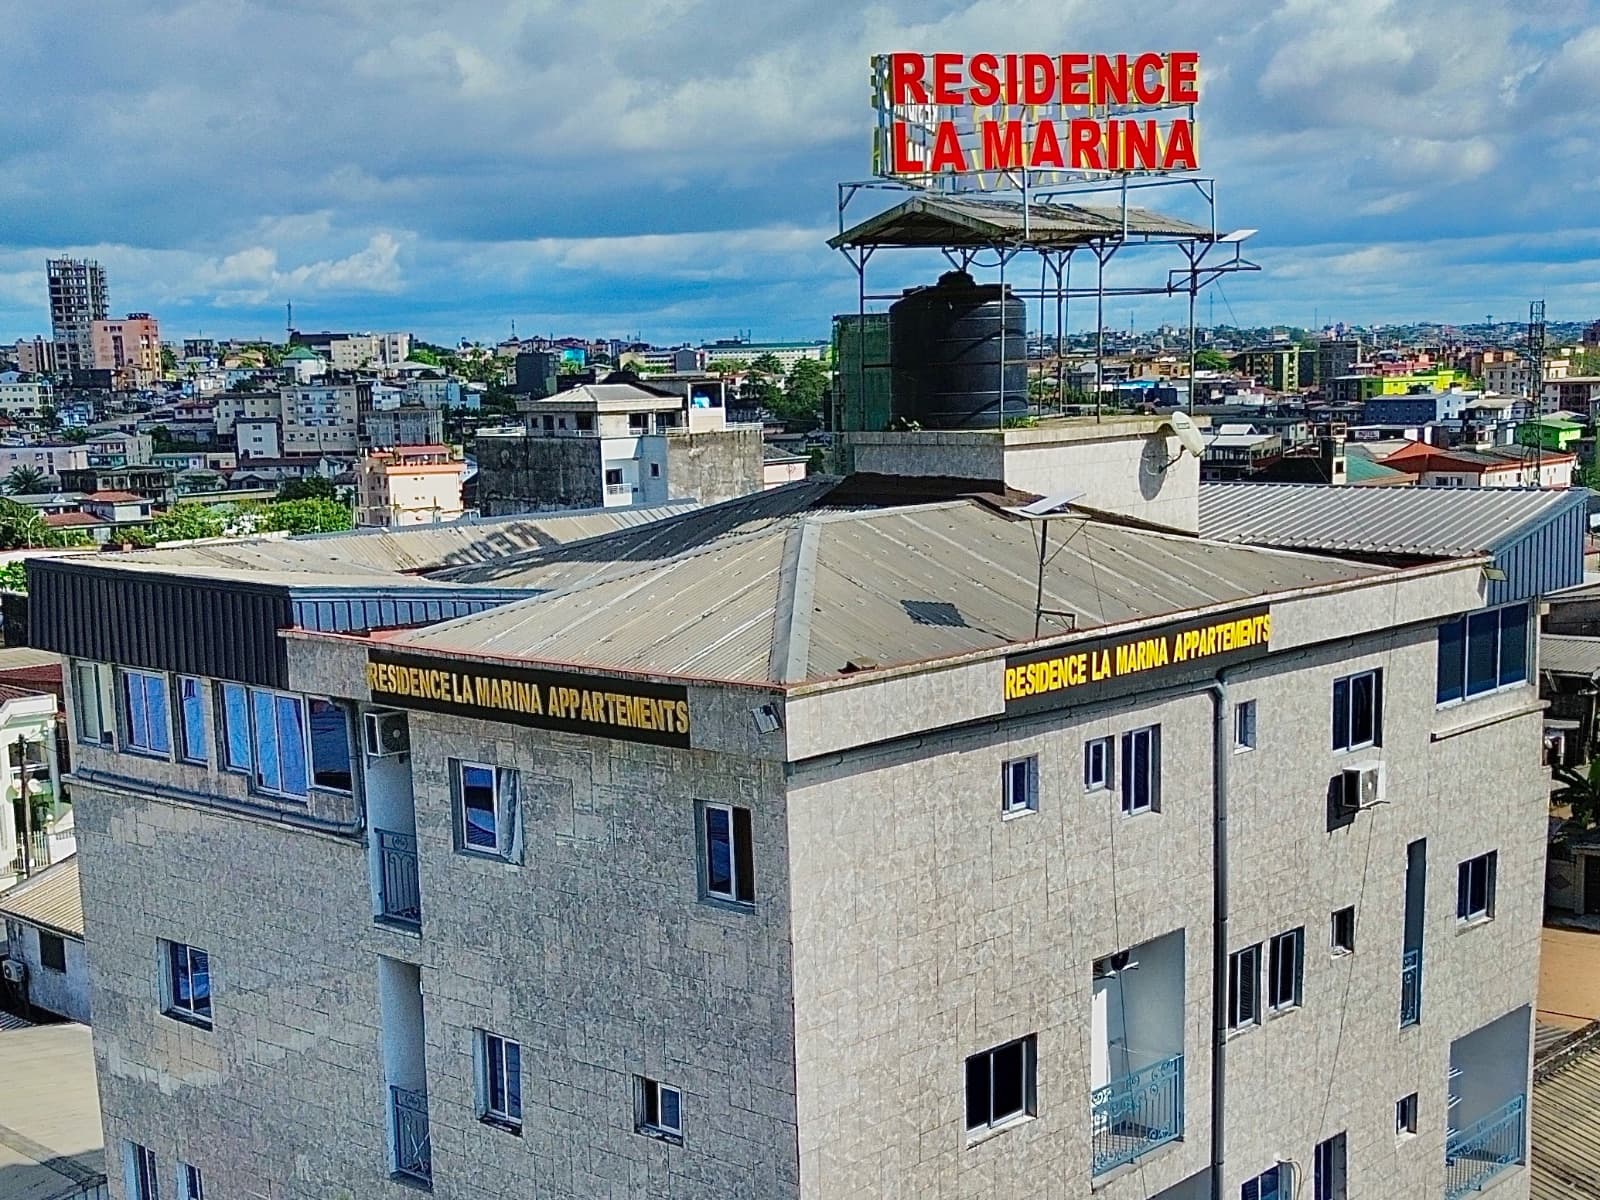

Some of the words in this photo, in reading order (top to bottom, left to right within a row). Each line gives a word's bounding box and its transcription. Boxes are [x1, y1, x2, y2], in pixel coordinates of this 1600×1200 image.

[891, 52, 1199, 105] RESIDENCE
[894, 120, 967, 173] LA
[982, 119, 1198, 170] MARINA
[1005, 653, 1087, 700] RESIDENCE
[1091, 650, 1111, 681] LA
[1116, 637, 1168, 675] MARINA
[1174, 615, 1271, 662] APPARTEMENTS
[367, 662, 451, 701] RESIDENCE
[452, 673, 474, 704] LA
[475, 677, 544, 715] MARINA
[548, 686, 688, 734] APPARTEMENTS
